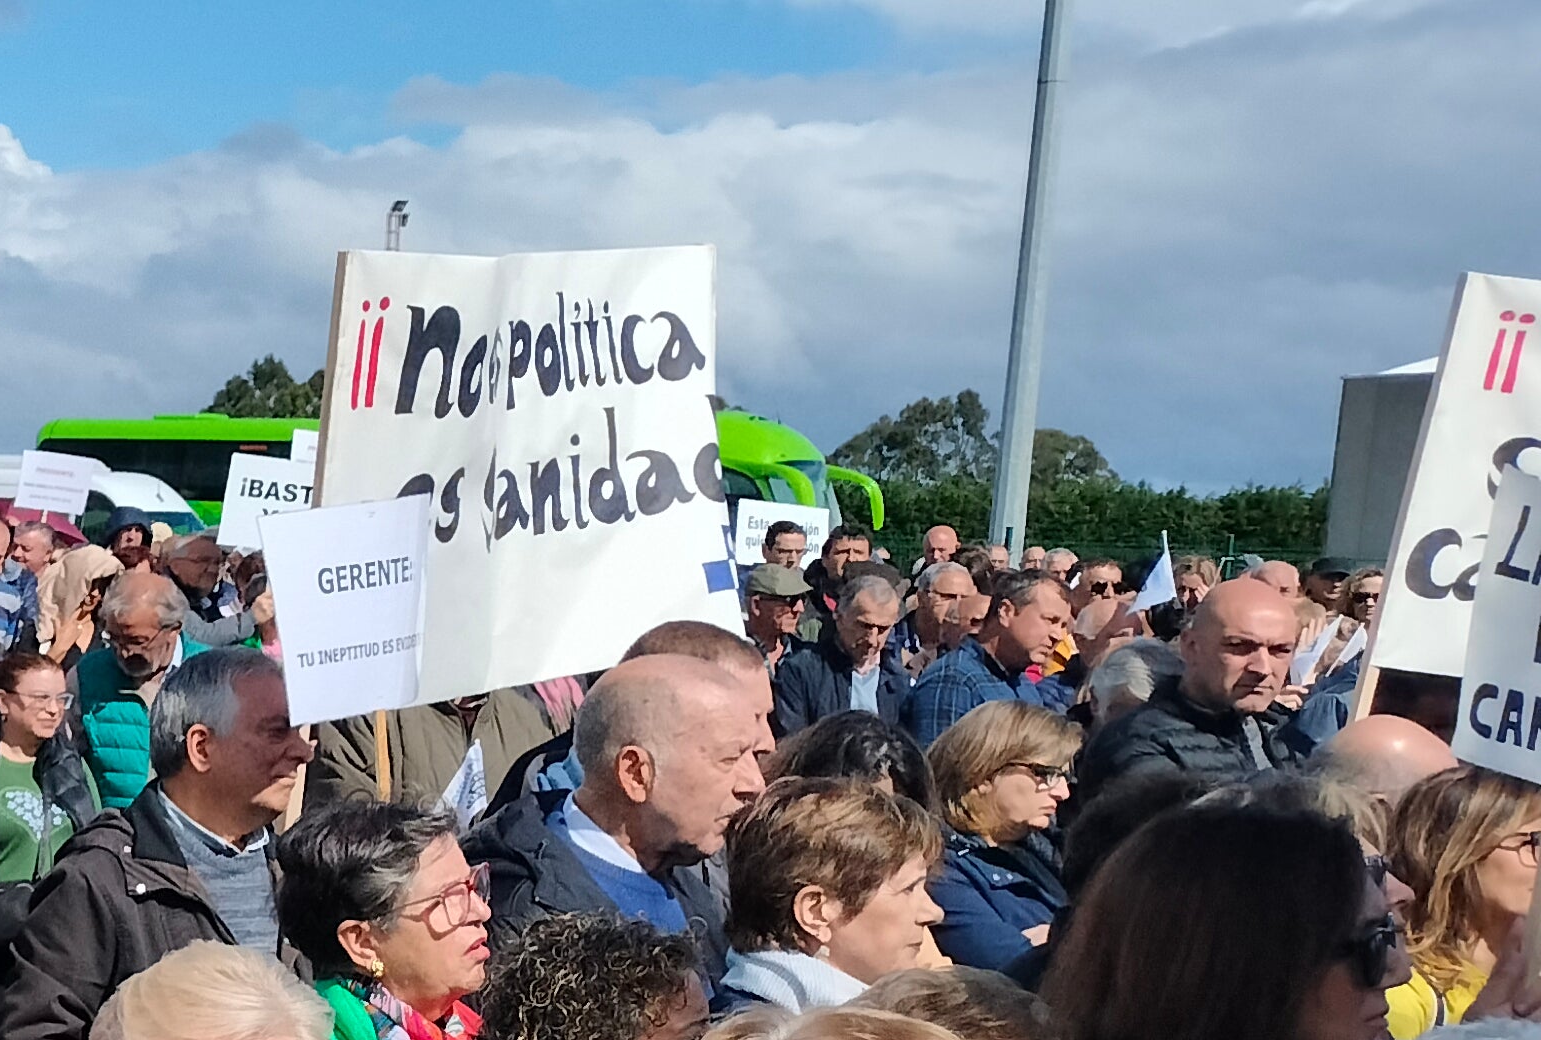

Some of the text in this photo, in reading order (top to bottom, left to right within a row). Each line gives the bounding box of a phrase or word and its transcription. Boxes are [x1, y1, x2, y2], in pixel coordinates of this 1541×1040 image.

[239, 477, 314, 504] ¡BAST
[318, 556, 413, 594] GERENTE:
[297, 652, 315, 668] TU
[318, 642, 380, 665] INEPTITUD
[382, 638, 394, 654] ES
